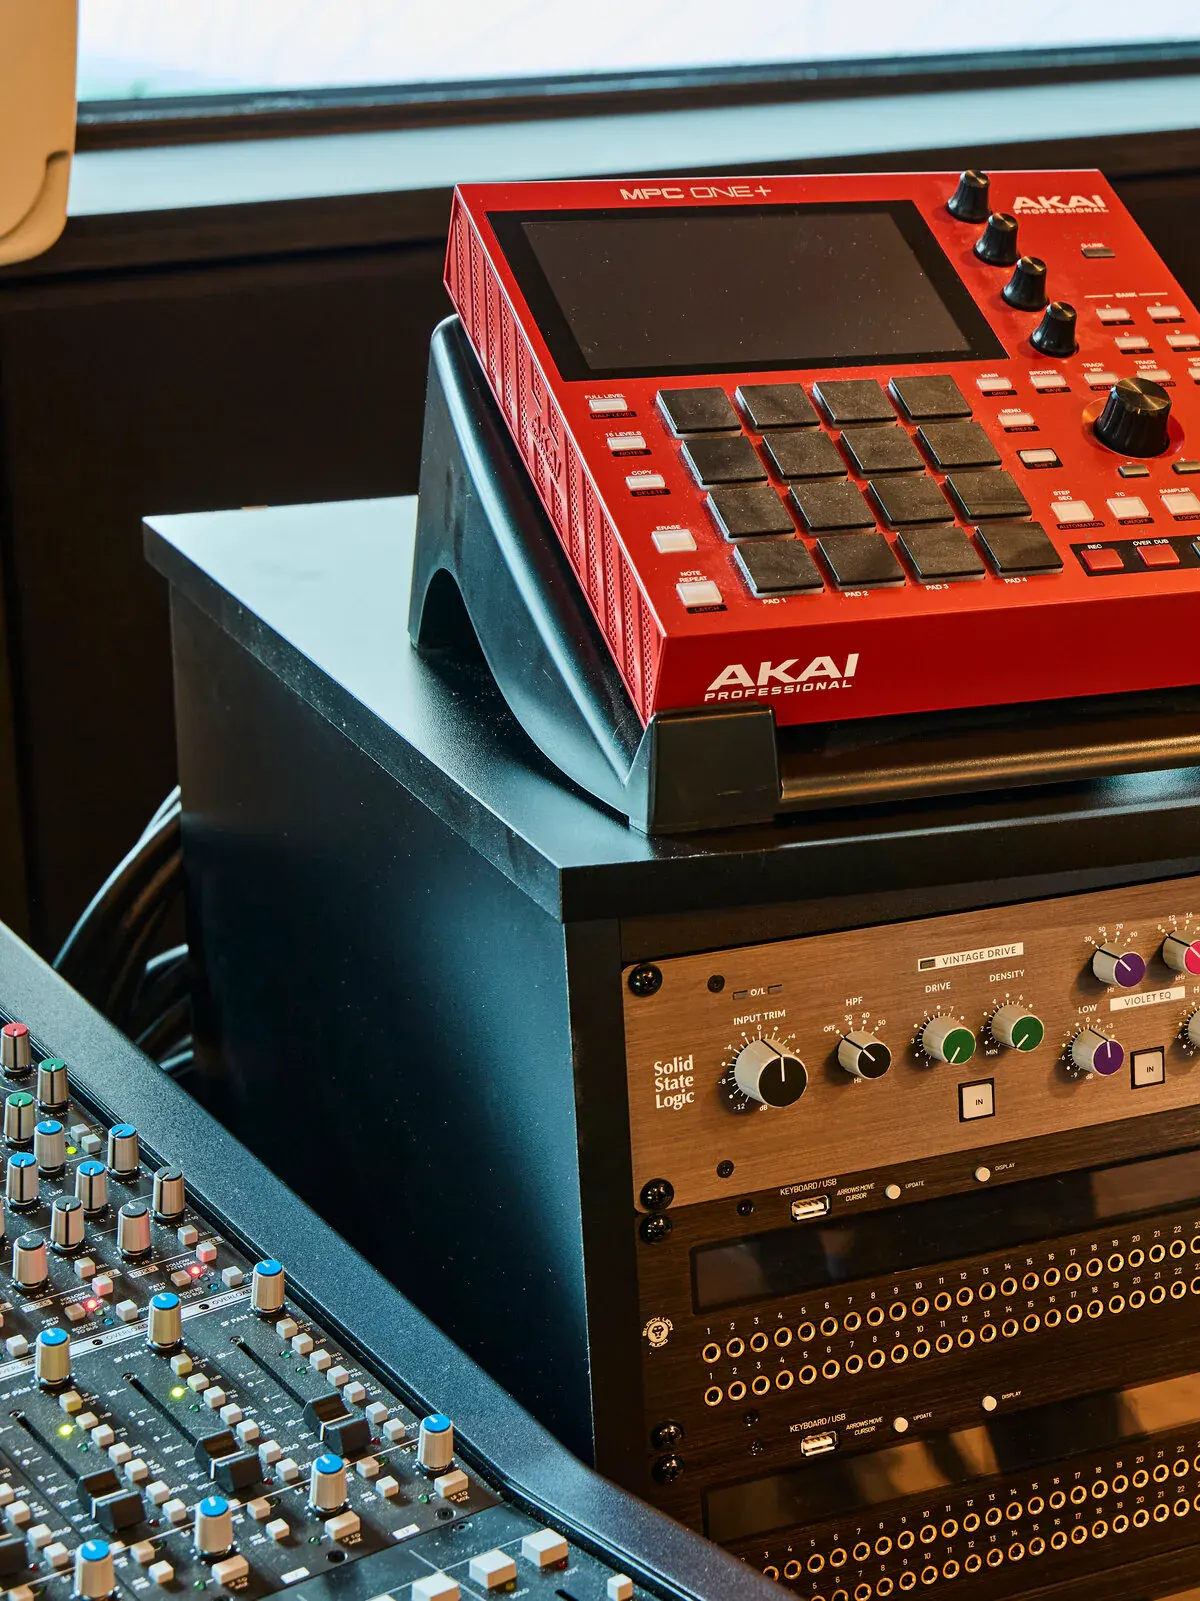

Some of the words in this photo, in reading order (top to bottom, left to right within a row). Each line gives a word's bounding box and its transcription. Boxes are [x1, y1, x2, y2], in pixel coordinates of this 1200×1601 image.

[620, 187, 684, 200] MPC
[690, 185, 772, 199] ONE+
[1012, 194, 1107, 210] AKAI
[1014, 207, 1109, 215] PROFESSIONAL
[706, 653, 860, 691] AKAI
[704, 680, 852, 702] PROFESSIONAL
[942, 951, 985, 965] VINTAGE
[987, 945, 1017, 958] DRIVE
[989, 969, 1025, 983] DENSITY
[750, 987, 766, 997] O/L
[925, 982, 951, 993] DRIVE
[845, 996, 864, 1007] HPF
[1123, 994, 1157, 1006] VIOLET
[1159, 991, 1172, 1001] EQ
[1078, 1004, 1098, 1014] LOW
[733, 1012, 761, 1025] INPUT
[763, 1009, 787, 1020] TRIM
[861, 1011, 870, 1019] 40
[877, 1019, 887, 1027] 50
[823, 1024, 836, 1033] OFF
[985, 1048, 998, 1056] MIN
[653, 1055, 694, 1077] Solid
[1146, 1065, 1154, 1073] IN
[655, 1072, 694, 1092] State
[655, 1089, 695, 1111] Logic
[975, 1098, 984, 1106] IN
[759, 1104, 768, 1112] dB
[994, 1162, 1015, 1171] DISPLAY
[779, 1181, 818, 1196] KEYBOARD
[822, 1178, 838, 1188] USB
[837, 1186, 859, 1196] ARROWS
[859, 1182, 875, 1192] MOVE
[905, 1180, 925, 1190] UPDATE
[845, 1192, 867, 1202] CURSOR
[230, 1314, 249, 1324] PAN
[1001, 1390, 1022, 1400] DISPLAY
[912, 1411, 933, 1421] UPDATE
[789, 1419, 828, 1433] KEYBOARD
[830, 1412, 847, 1423] USB
[846, 1419, 868, 1431] ARROWS
[867, 1416, 884, 1426] MOVE
[854, 1425, 877, 1436] CURSOR
